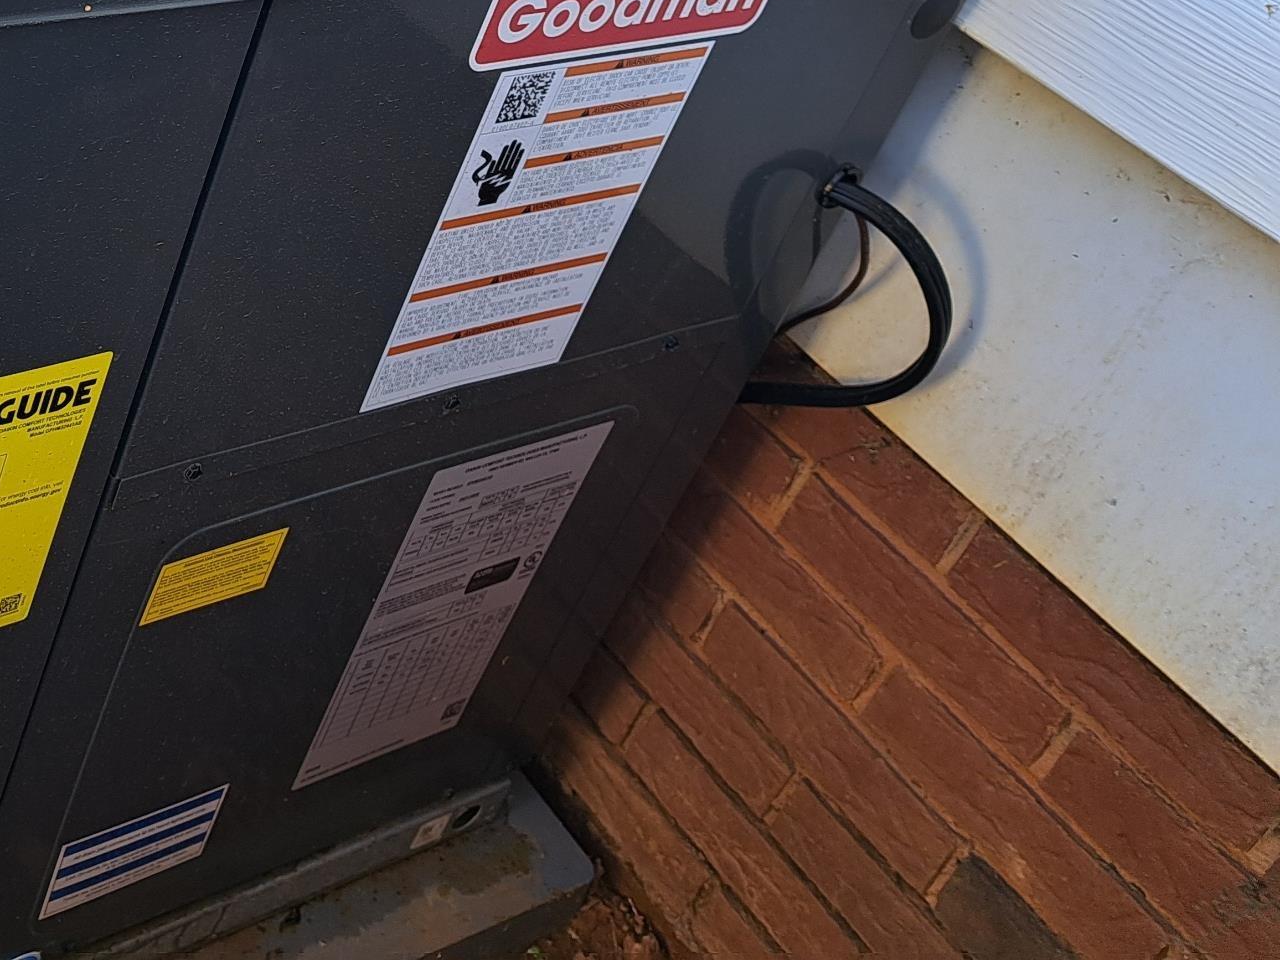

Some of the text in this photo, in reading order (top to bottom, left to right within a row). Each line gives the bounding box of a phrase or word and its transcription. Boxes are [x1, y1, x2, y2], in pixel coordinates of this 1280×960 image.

[626, 55, 661, 67] WARNING
[532, 199, 567, 212] WARNING
[501, 269, 535, 282] WARNING
[17, 418, 45, 428] COMFORT
[45, 407, 86, 422] TECHNOLOGIES
[7, 490, 27, 500] energy
